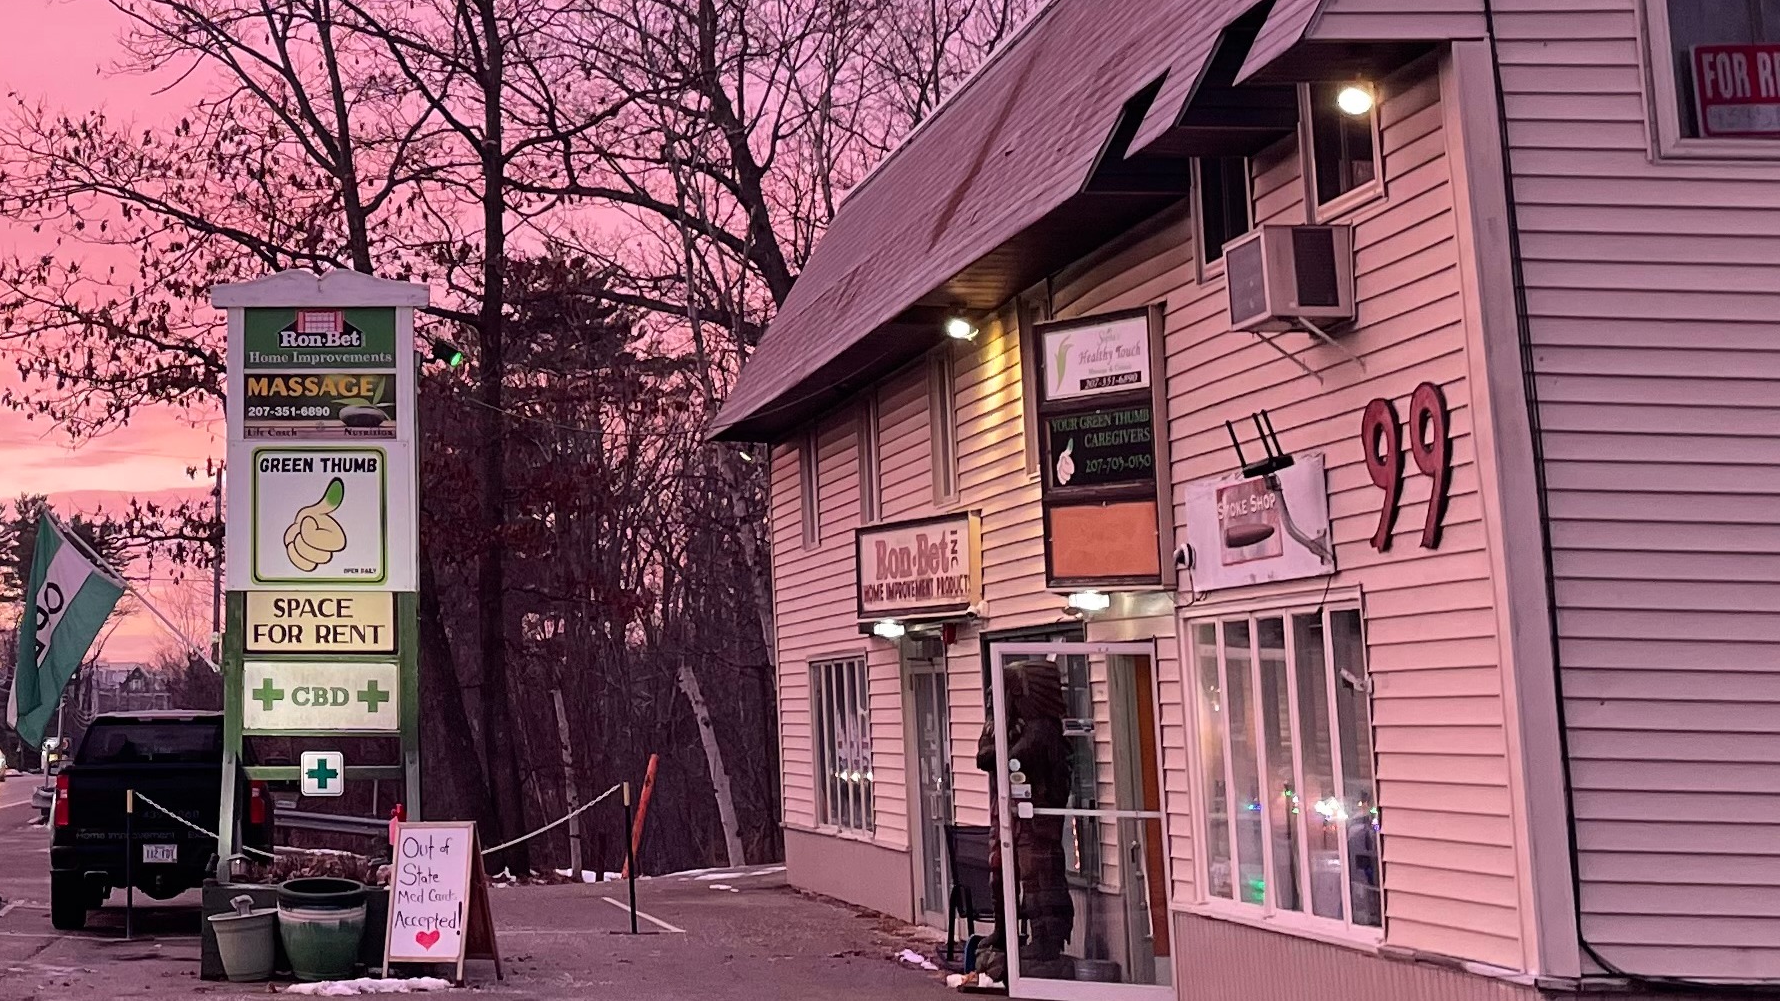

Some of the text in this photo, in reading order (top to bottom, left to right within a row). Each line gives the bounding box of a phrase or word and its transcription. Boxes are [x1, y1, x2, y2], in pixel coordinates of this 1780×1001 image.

[1701, 51, 1751, 99] FOR
[249, 351, 393, 368] Home Improvements
[1078, 340, 1141, 365] Healthy Touch
[247, 376, 374, 398] MASSAGE
[248, 406, 331, 418] 207-351-6890
[1052, 408, 1150, 433] YOUR GREEN THUMB
[1084, 427, 1151, 448] CAREGIVERS
[259, 457, 377, 473] GREEN THUMB
[1361, 381, 1453, 553] 99
[1249, 492, 1276, 513] SHOP
[863, 582, 884, 604] HOME
[273, 598, 353, 618] SPACE
[253, 624, 385, 644] FOR RENT
[291, 687, 350, 707] CBD
[403, 835, 453, 860] Out of
[400, 863, 440, 886] State
[398, 888, 424, 904] Med
[394, 901, 463, 935] Accepted!
